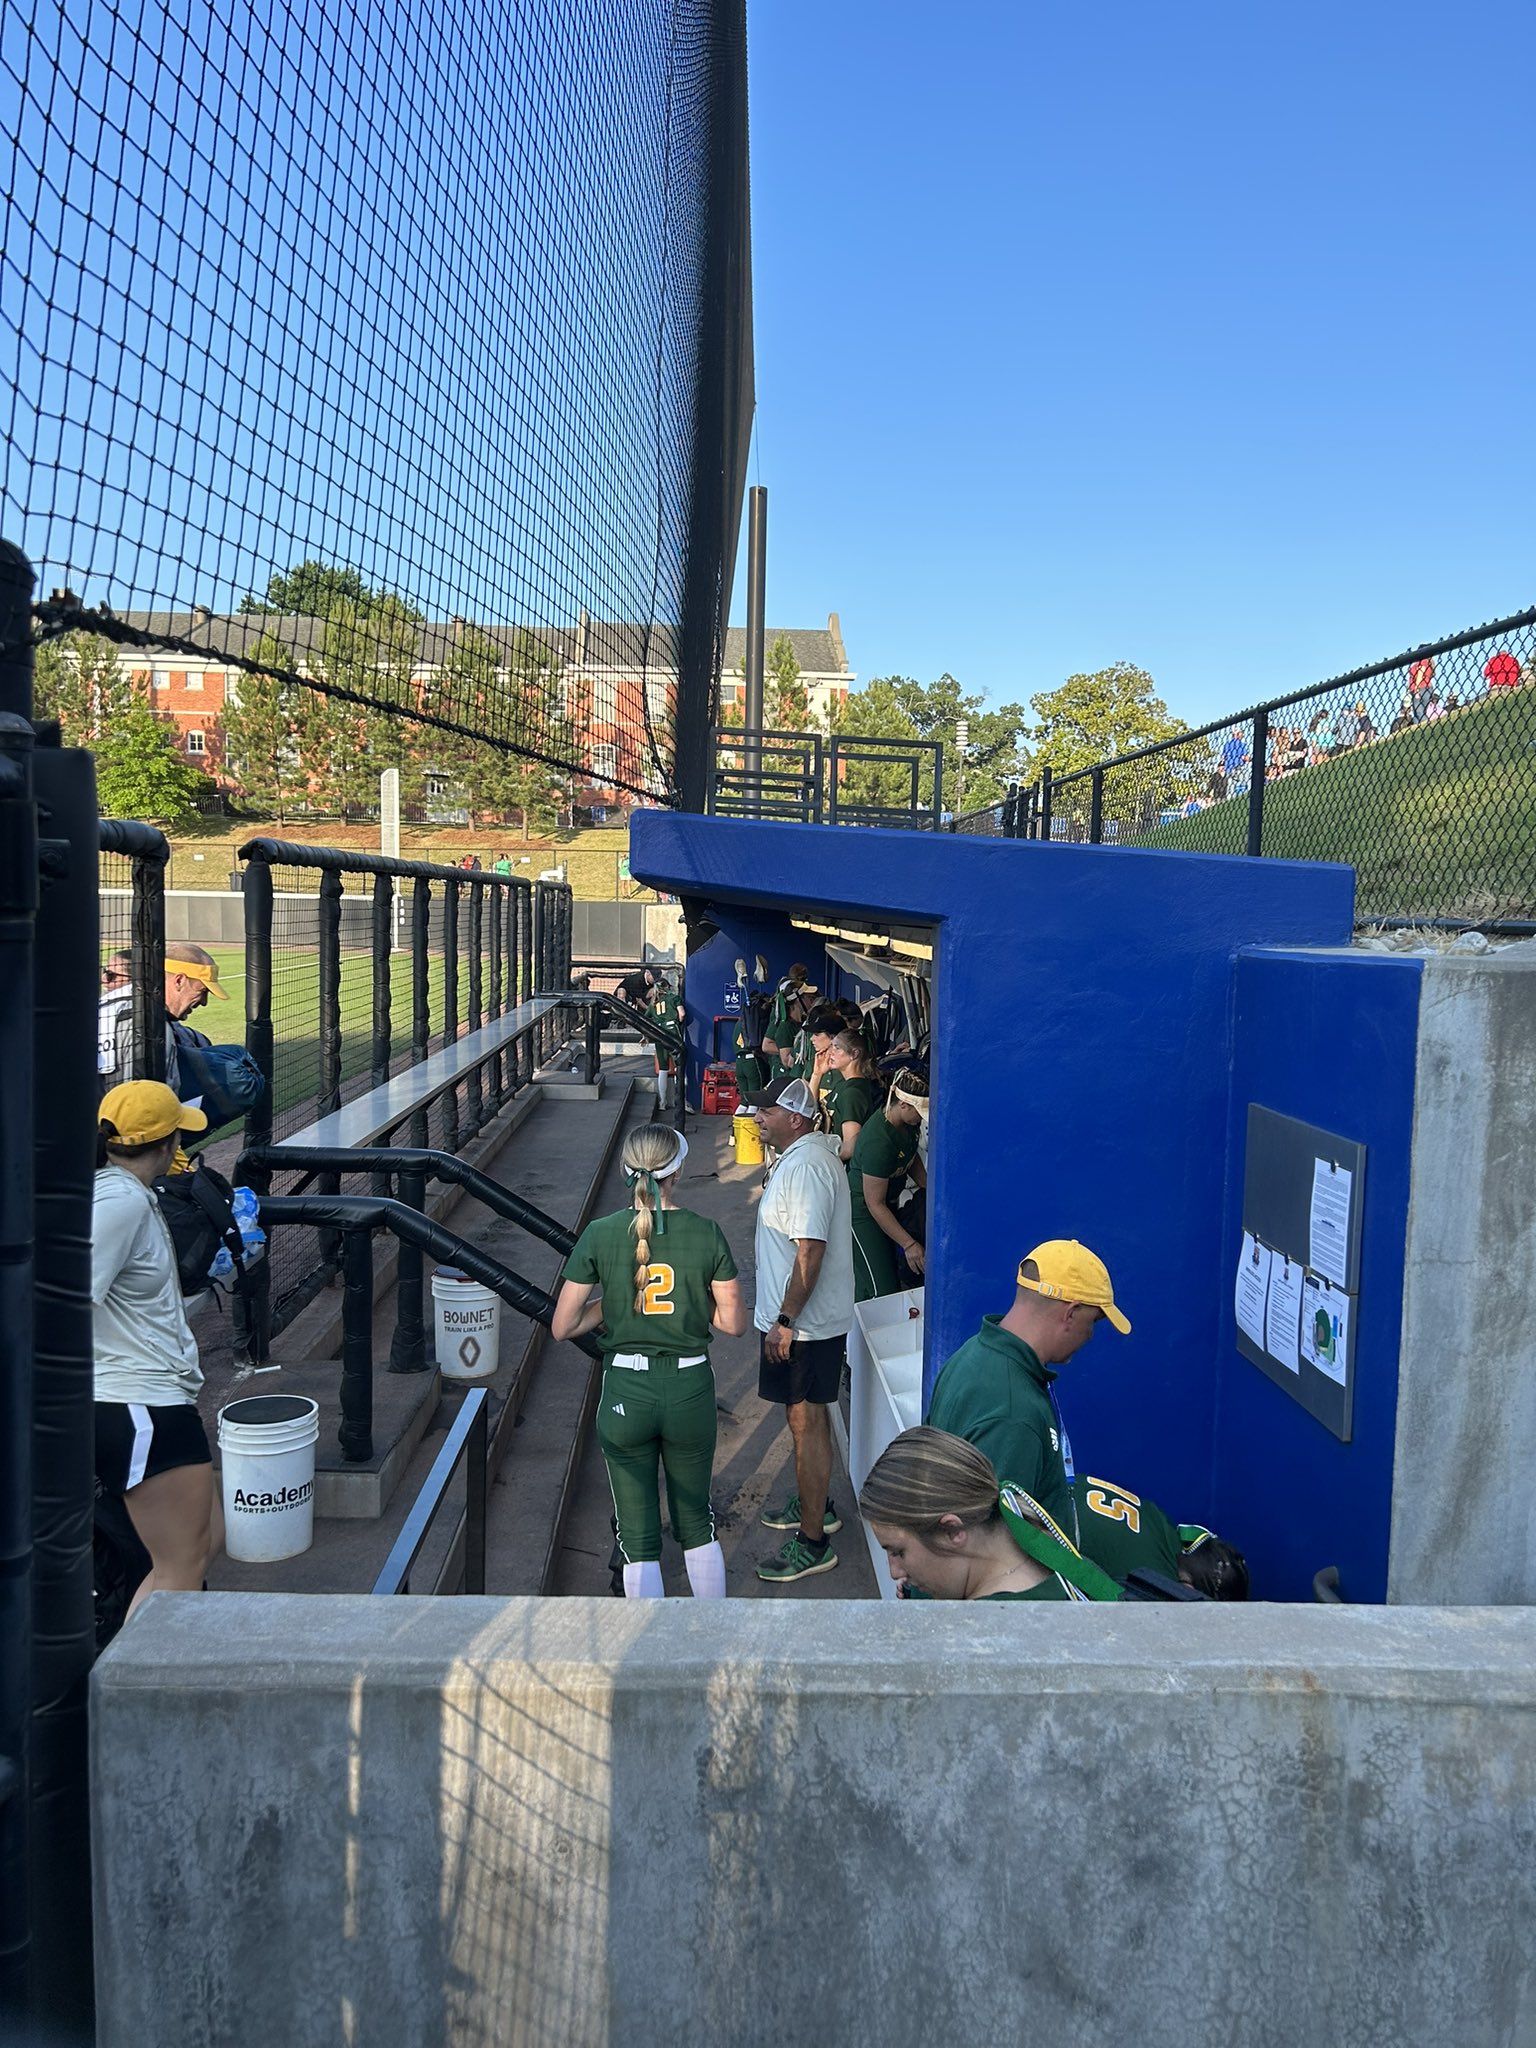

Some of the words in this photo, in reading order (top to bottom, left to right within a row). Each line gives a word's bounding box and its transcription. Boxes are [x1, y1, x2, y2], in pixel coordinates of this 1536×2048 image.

[655, 1001, 666, 1015] 11
[642, 1263, 675, 1315] 2
[443, 1307, 495, 1324] BOWNET
[444, 1325, 462, 1333] TRAIN
[483, 1322, 495, 1331] PRO
